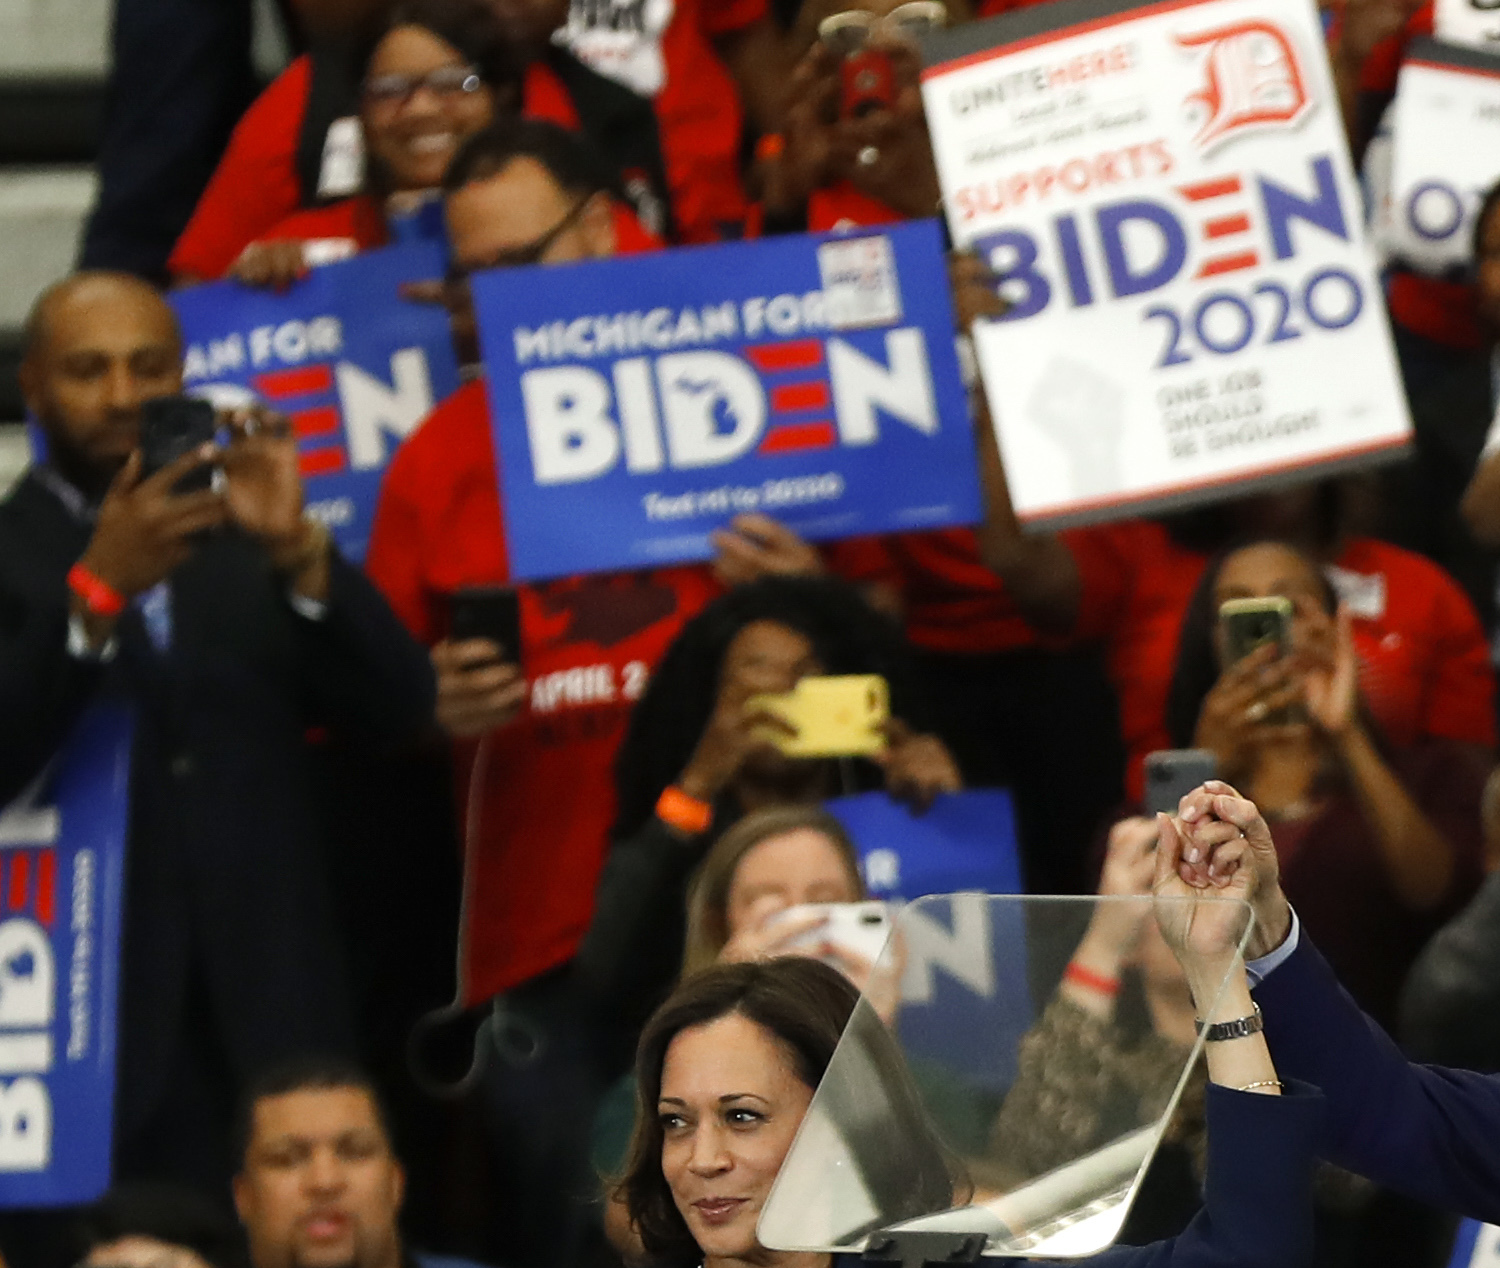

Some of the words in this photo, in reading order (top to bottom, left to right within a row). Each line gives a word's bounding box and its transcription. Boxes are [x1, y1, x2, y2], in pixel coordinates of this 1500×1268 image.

[955, 138, 1174, 221] SUPPORTS
[969, 153, 1350, 323] BIDEN
[514, 300, 740, 364] MICHIGAN
[1144, 266, 1365, 369] 2020
[520, 326, 941, 487] BIDEN
[530, 663, 616, 713] APRIL
